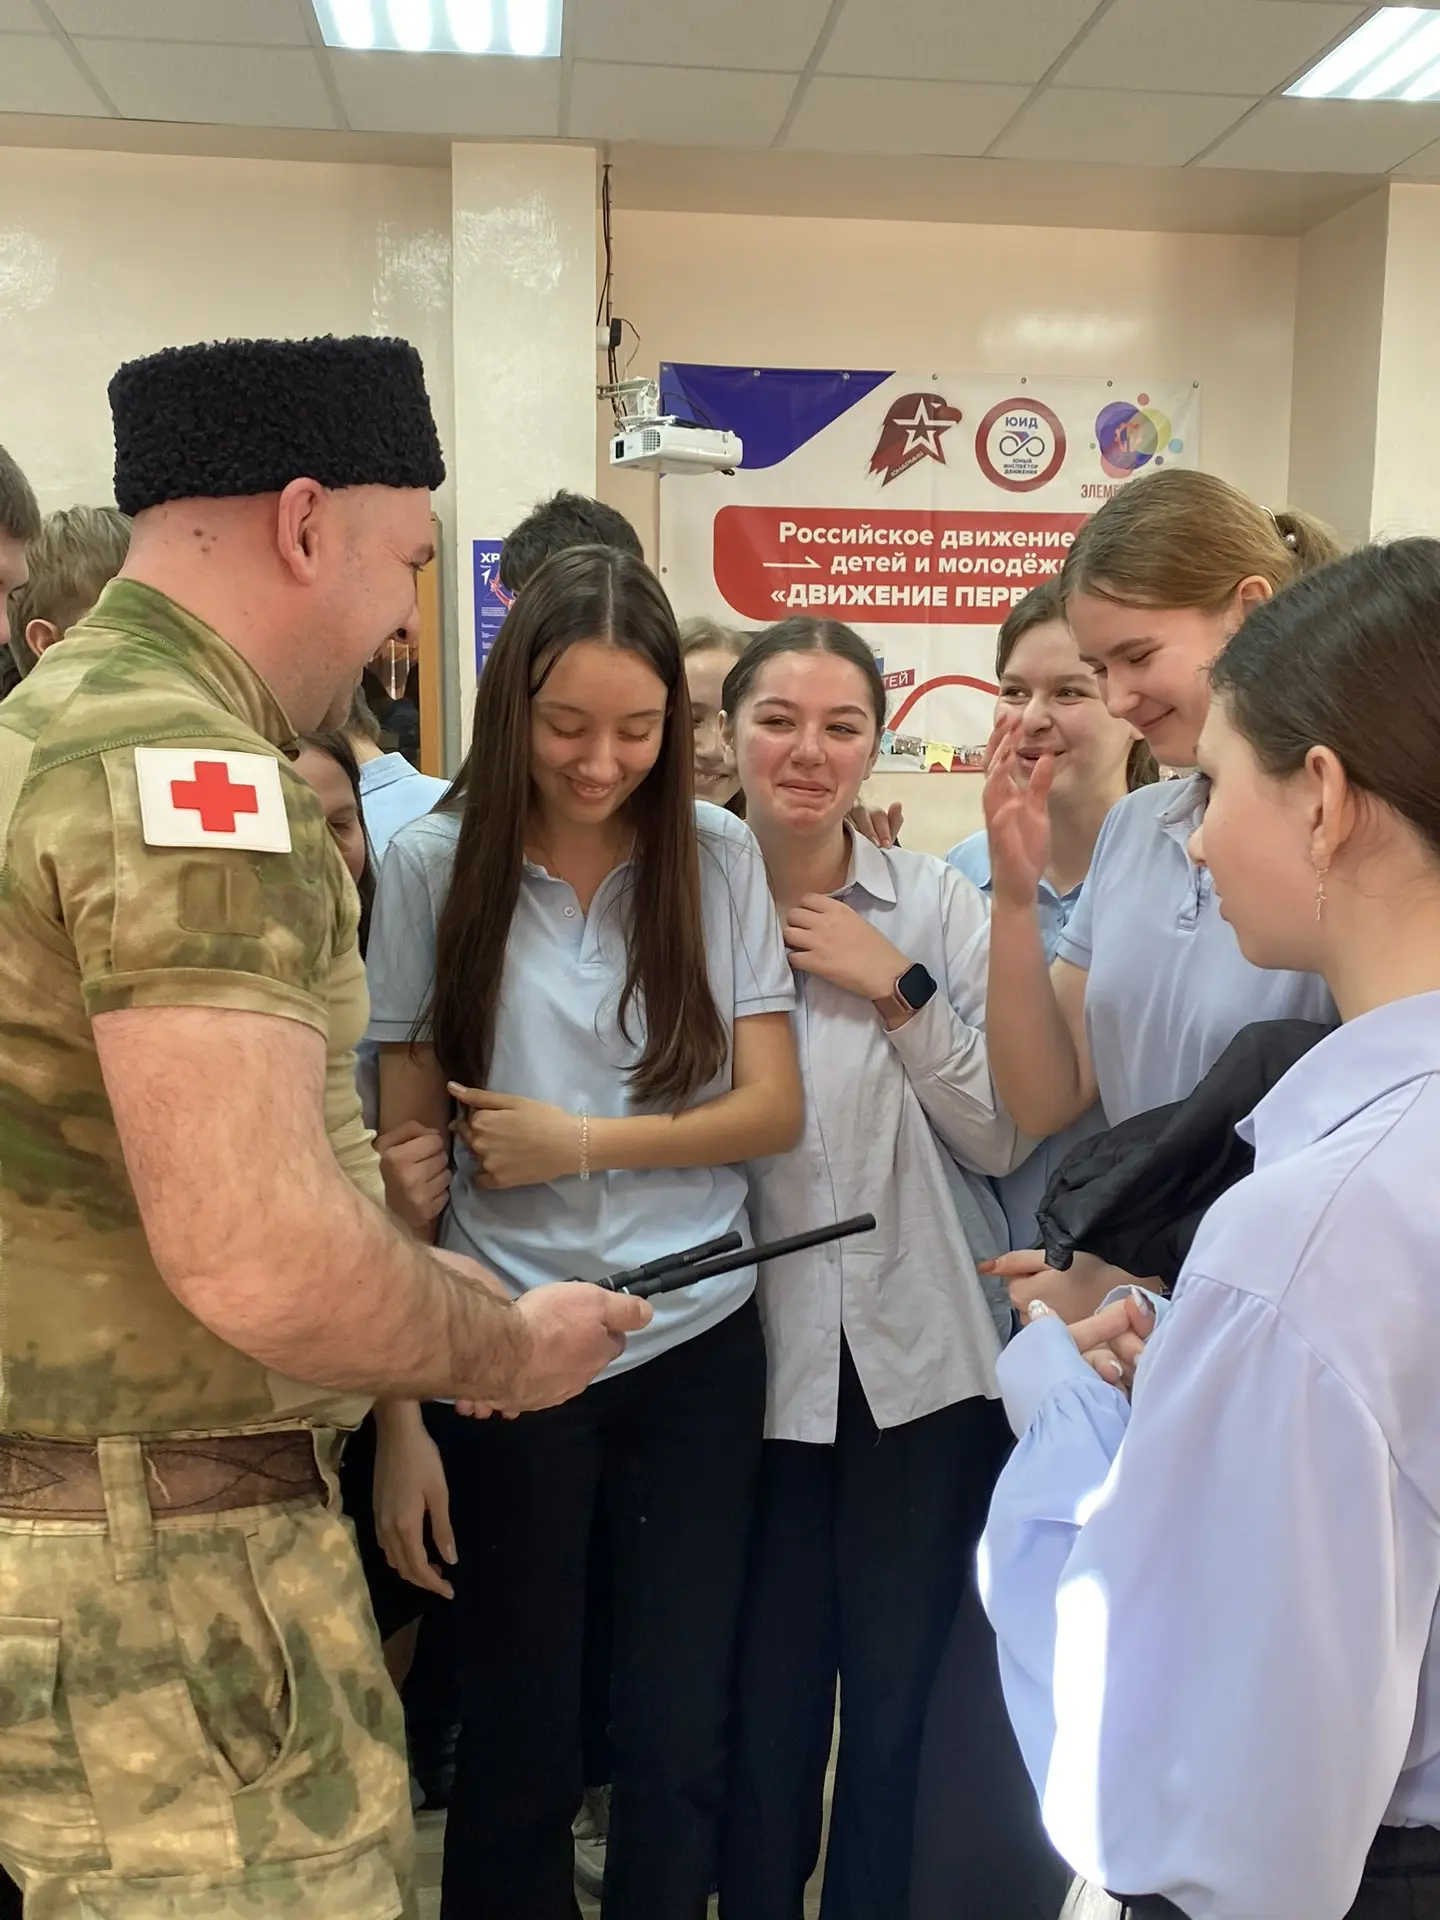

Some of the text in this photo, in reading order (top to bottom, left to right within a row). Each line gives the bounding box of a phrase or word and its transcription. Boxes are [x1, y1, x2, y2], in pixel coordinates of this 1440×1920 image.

[1005, 416, 1038, 430] ЮИД
[1080, 484, 1121, 499] ЭЛЕМЕ
[779, 521, 1076, 550] Российское движение
[830, 552, 907, 575] детей
[914, 556, 931, 573] и
[770, 583, 1034, 608] «ДВИЖЕНИЕ ПЕРВ
[883, 671, 909, 688] ТЕЙ
